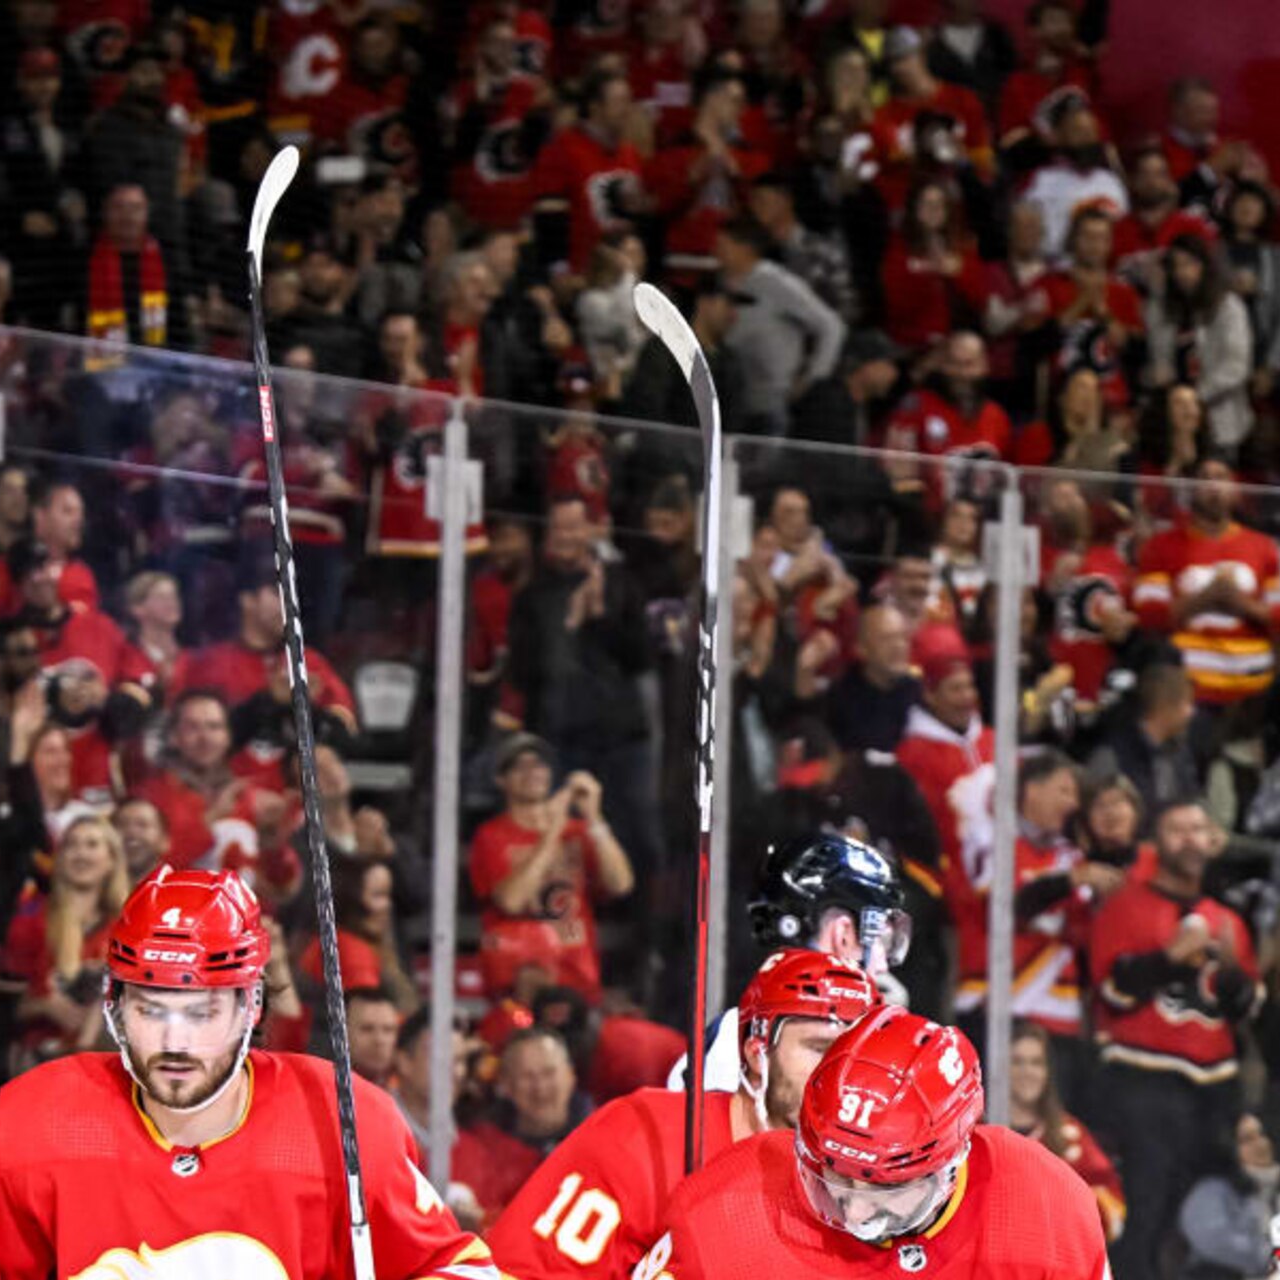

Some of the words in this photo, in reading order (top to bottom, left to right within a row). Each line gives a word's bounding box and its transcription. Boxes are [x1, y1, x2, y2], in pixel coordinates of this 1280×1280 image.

[161, 908, 181, 928] 4
[143, 949, 197, 963] CCM
[837, 1093, 875, 1128] 91
[825, 1140, 877, 1162] CCM
[532, 1171, 621, 1266] 10
